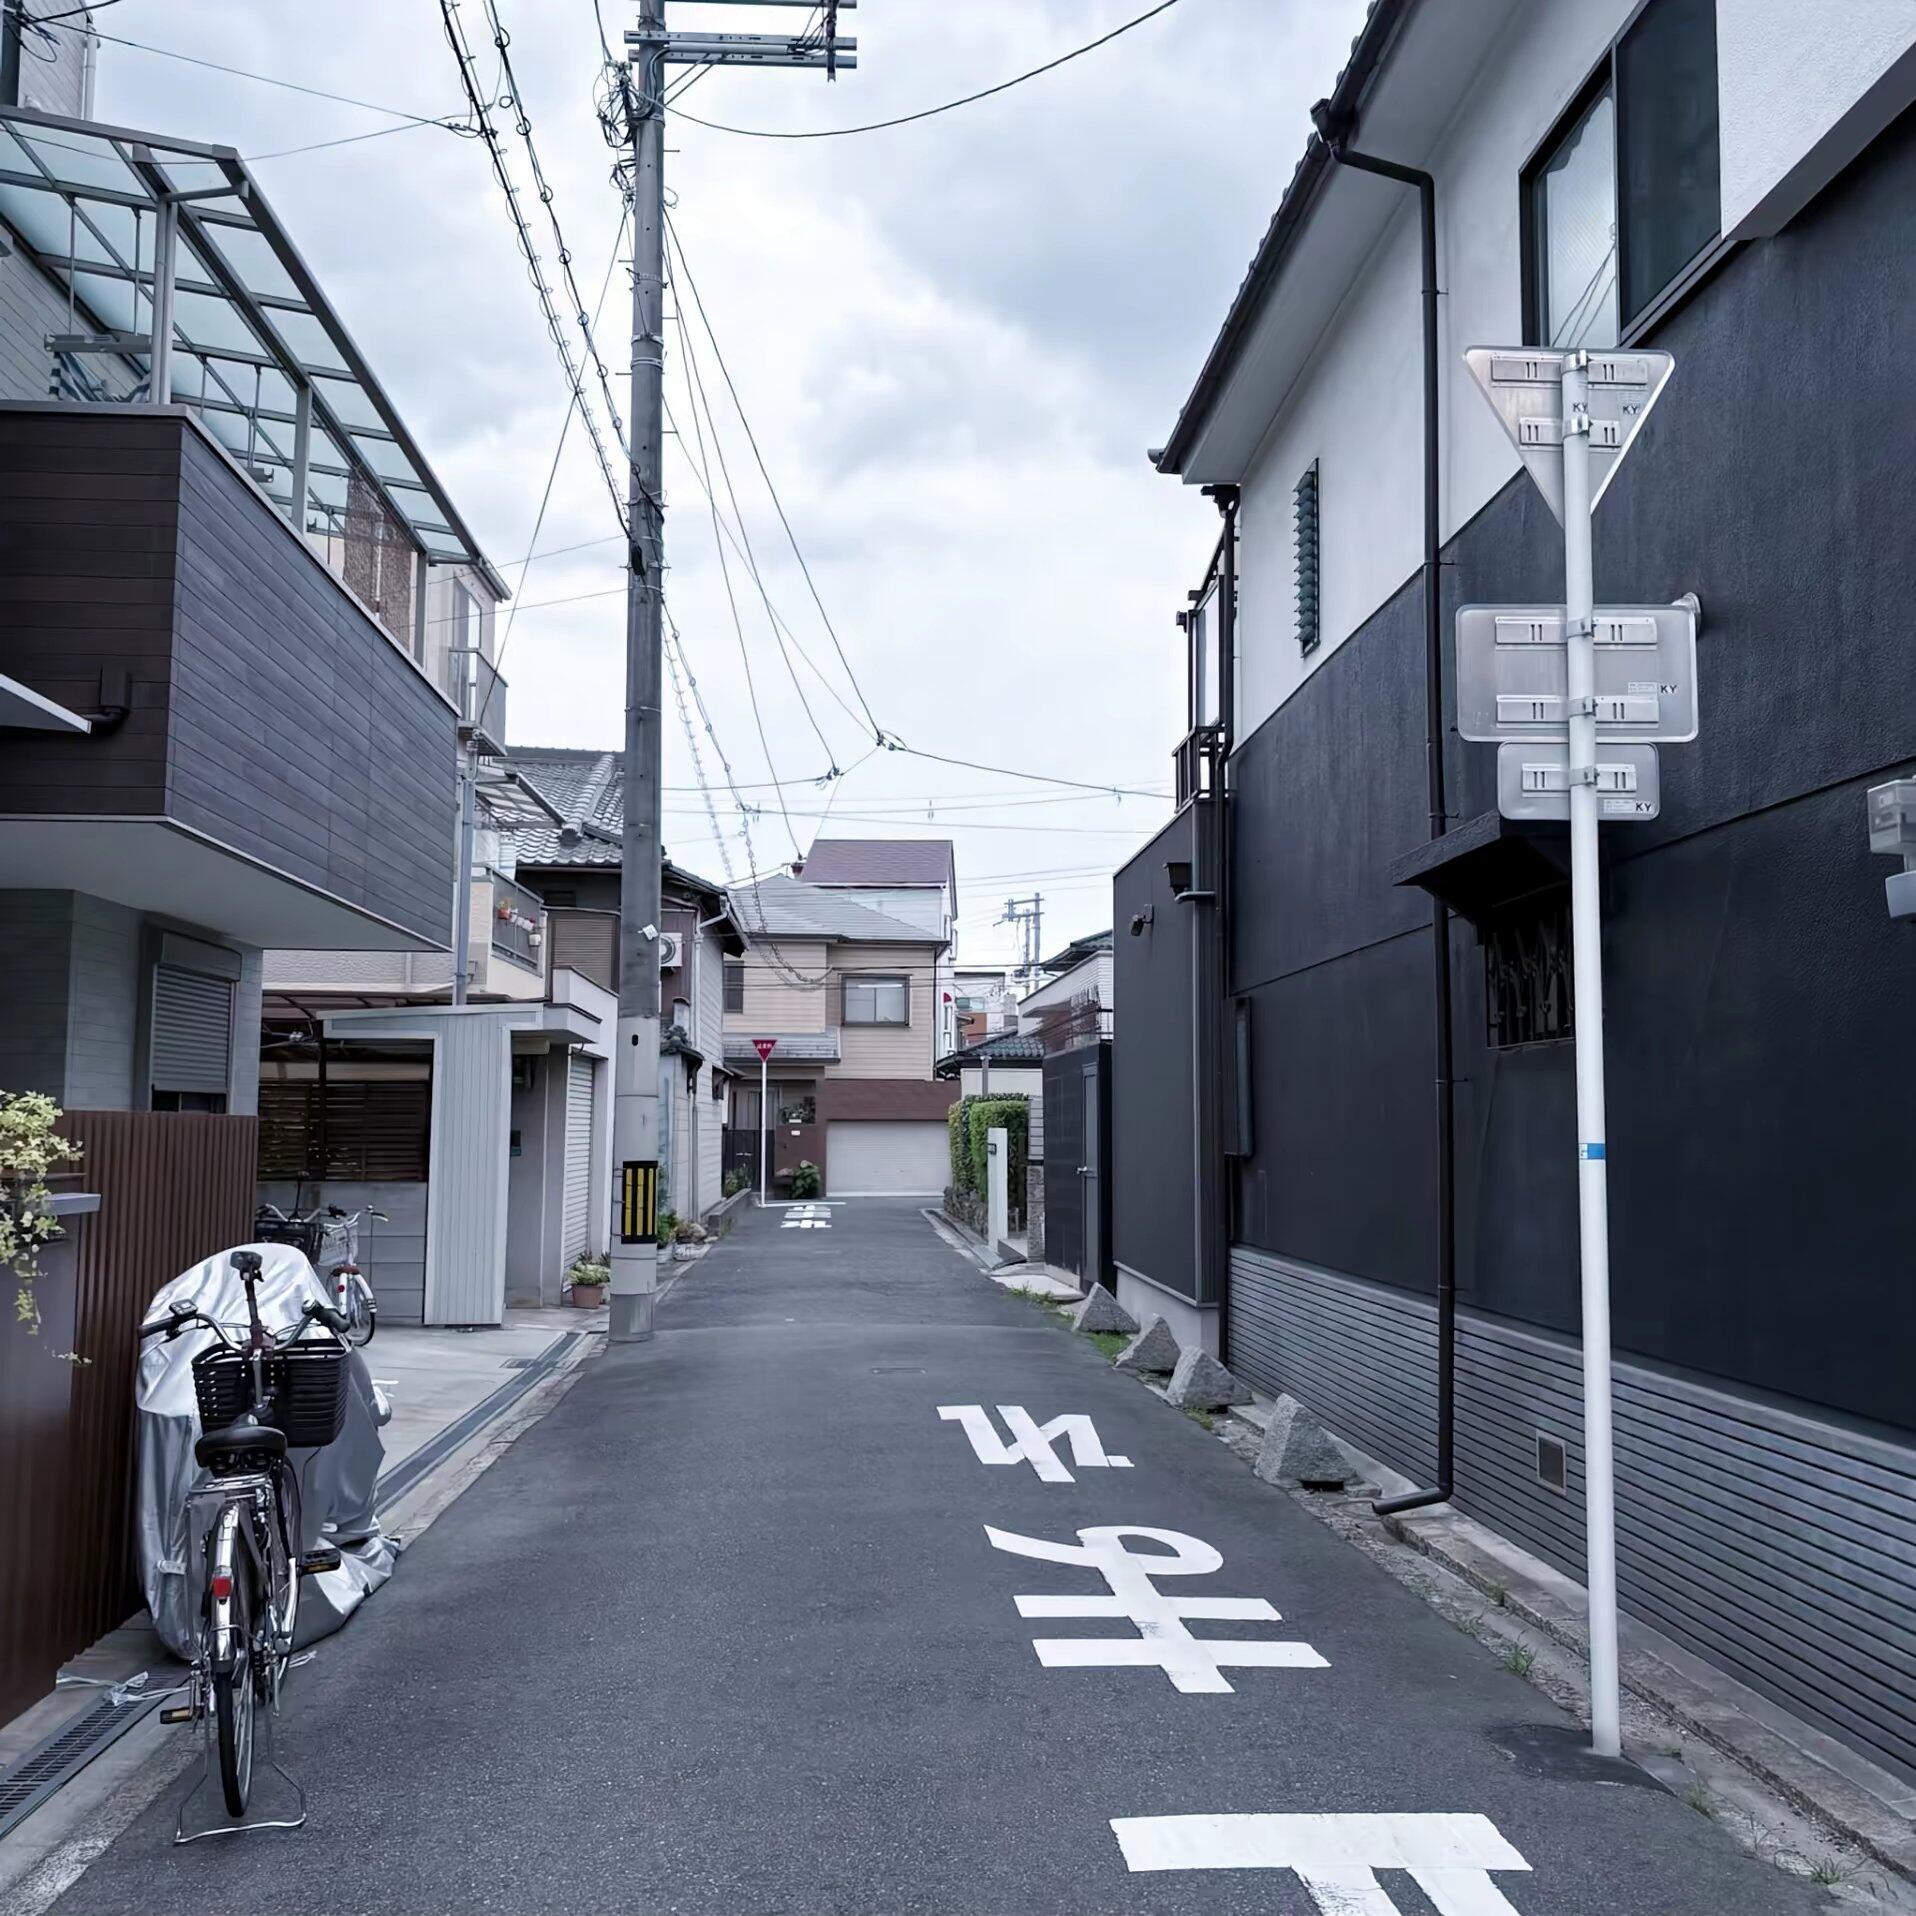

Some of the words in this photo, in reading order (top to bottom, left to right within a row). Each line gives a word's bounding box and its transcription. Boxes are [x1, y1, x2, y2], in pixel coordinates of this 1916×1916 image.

[1623, 405, 1639, 414] KY
[1660, 684, 1677, 693] KY
[1636, 803, 1651, 811] KY
